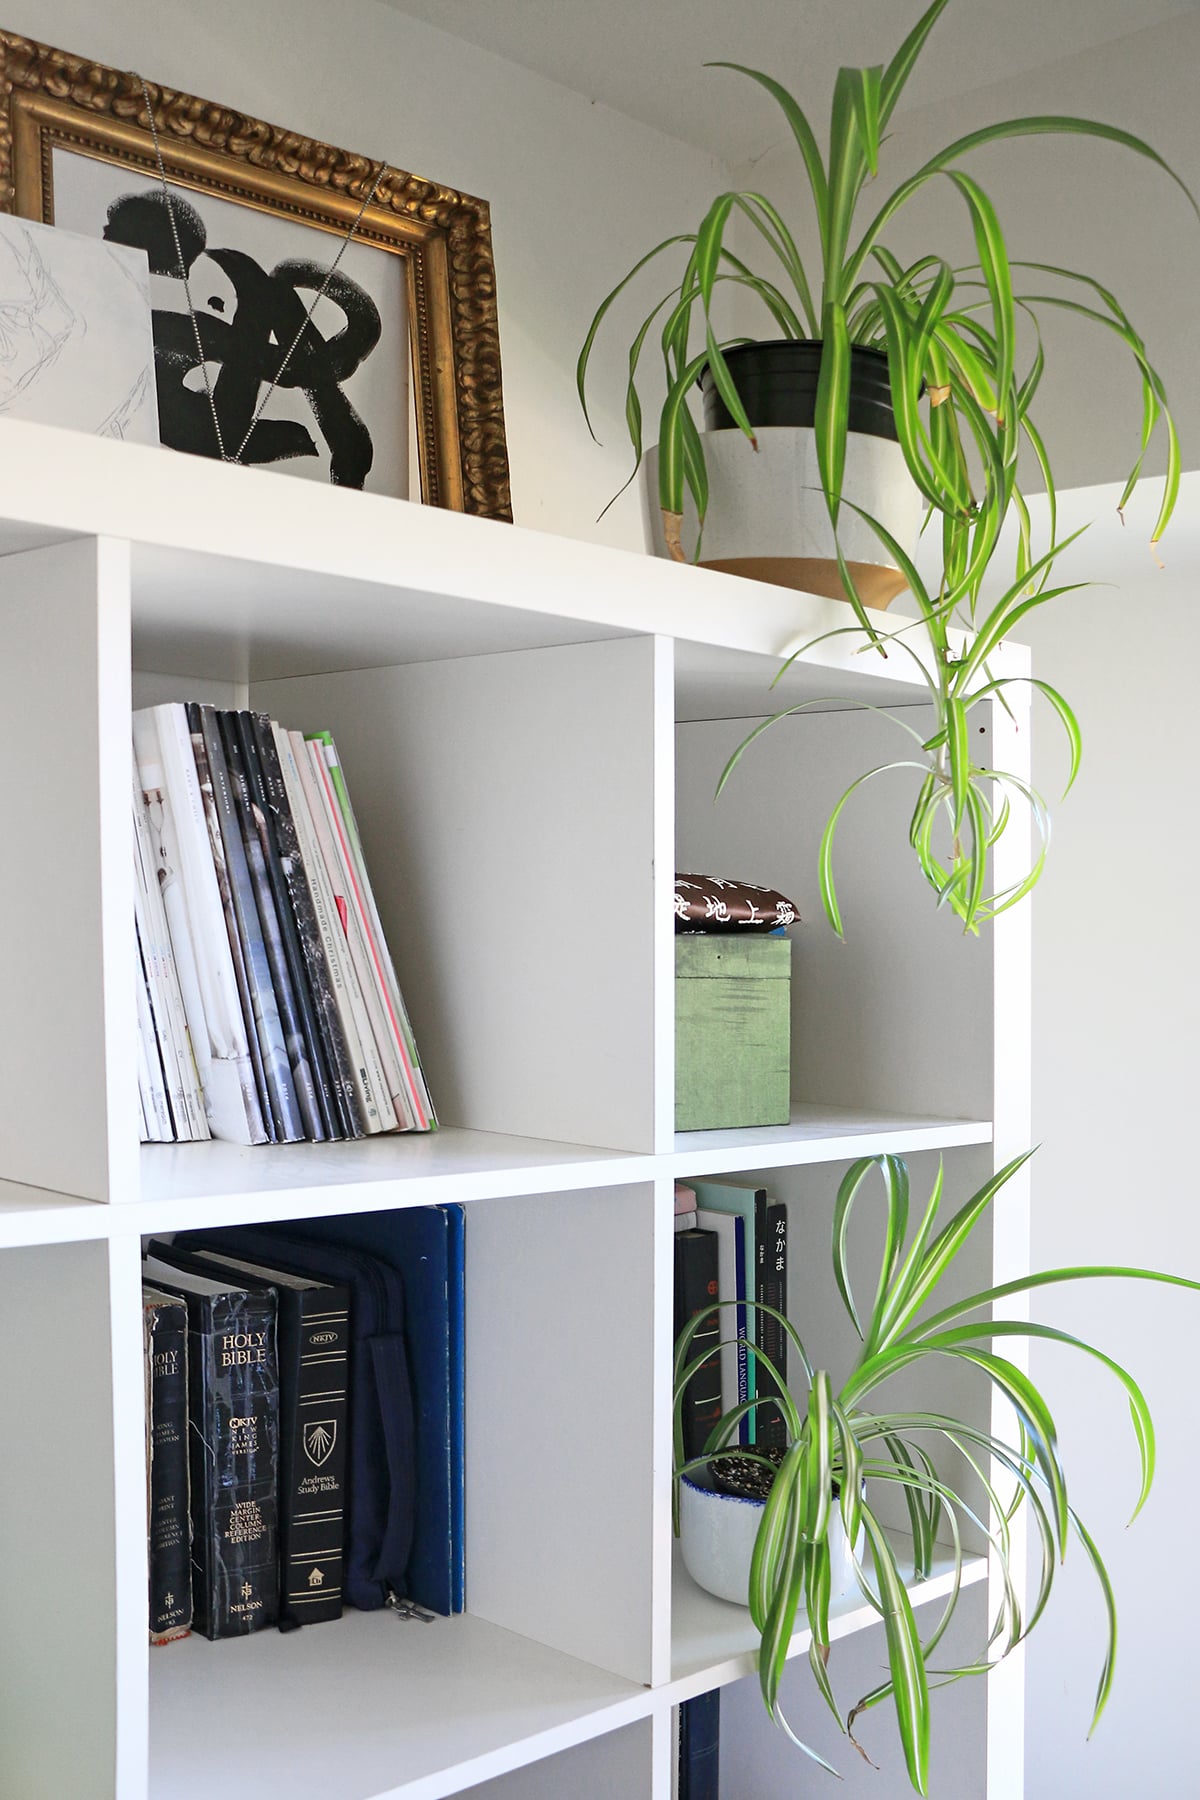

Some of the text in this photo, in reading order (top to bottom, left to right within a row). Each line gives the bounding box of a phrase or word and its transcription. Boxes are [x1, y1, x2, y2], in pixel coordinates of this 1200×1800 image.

[239, 774, 251, 812] LIGHTING
[310, 878, 330, 932] Handmade
[324, 936, 344, 989] Christmas
[360, 1078, 374, 1102] Living
[776, 1220, 786, 1271] なかま
[222, 1332, 266, 1350] HOLY
[313, 1334, 336, 1342] NKJV
[738, 1327, 746, 1361] WORLD
[222, 1348, 266, 1366] BIBLE
[155, 1363, 179, 1377] IBLE
[230, 1416, 258, 1428] NKJV
[232, 1426, 258, 1434] NEW
[232, 1434, 258, 1442] KING
[232, 1440, 258, 1450] JAMES
[302, 1475, 335, 1486] Andrews
[298, 1482, 340, 1494] Study Bible
[236, 1500, 256, 1509] WIDE
[230, 1506, 261, 1516] MARGIN
[224, 1524, 266, 1538] REFERENCE
[230, 1520, 262, 1531] COLUMN
[231, 1533, 262, 1544] EDITION
[230, 1601, 263, 1613] NELSON
[158, 1609, 184, 1622] NELSON
